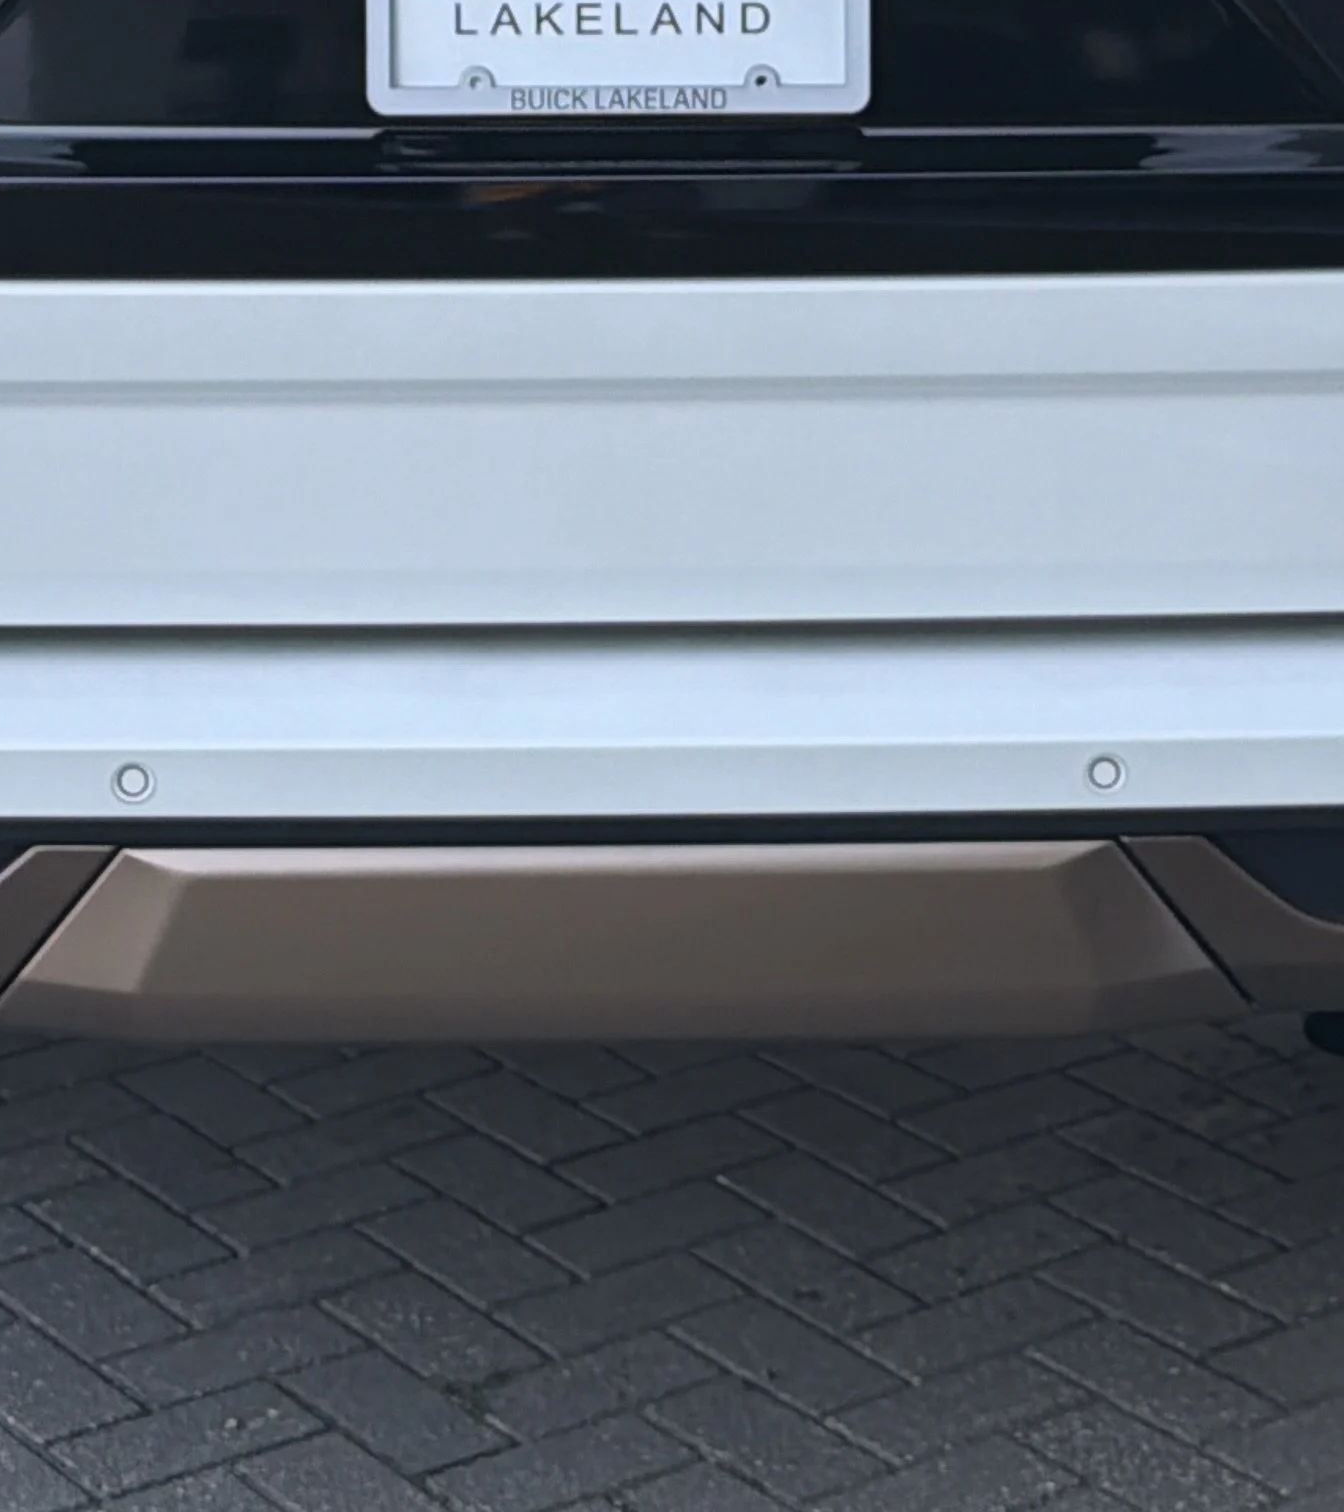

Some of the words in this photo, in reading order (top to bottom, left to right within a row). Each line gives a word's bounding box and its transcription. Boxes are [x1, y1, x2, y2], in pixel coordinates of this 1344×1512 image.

[453, 1, 772, 36] LAKELAND
[510, 88, 589, 112] BUICK
[594, 88, 728, 112] LAKELAND
